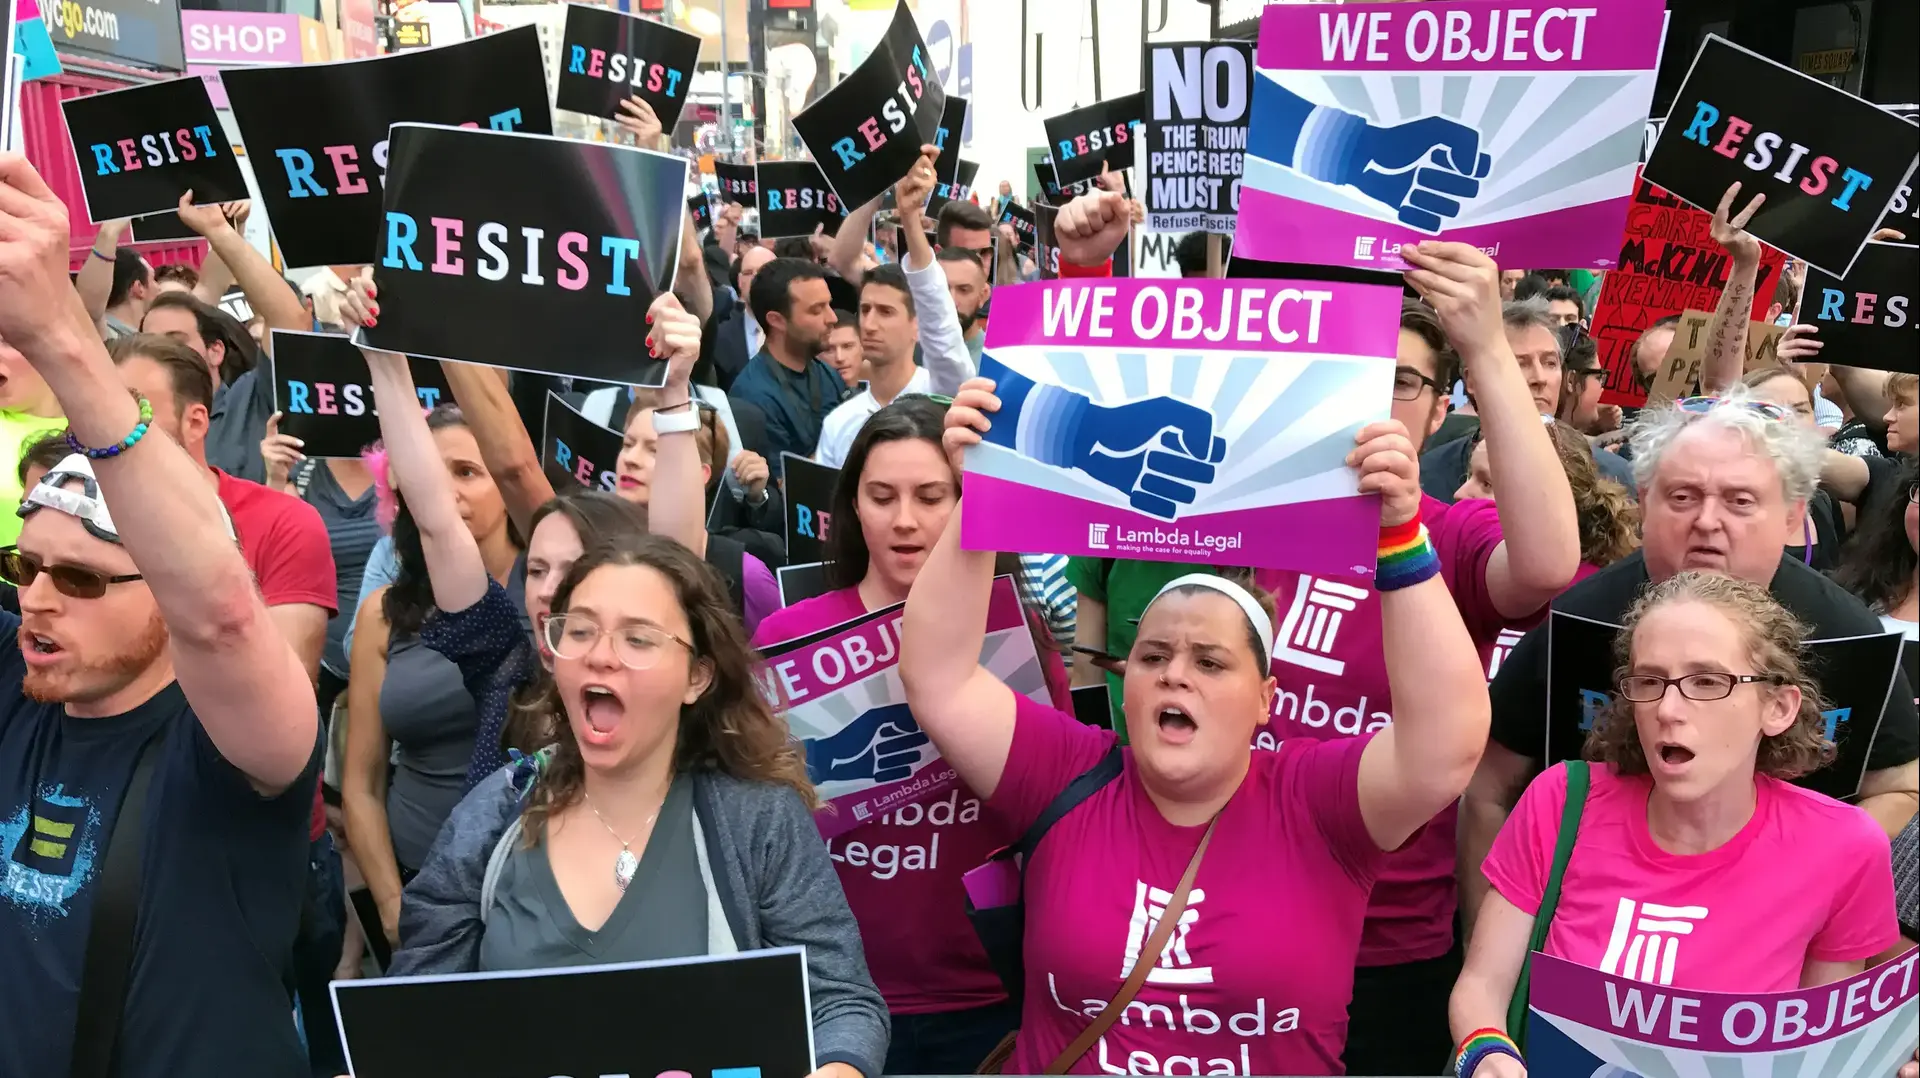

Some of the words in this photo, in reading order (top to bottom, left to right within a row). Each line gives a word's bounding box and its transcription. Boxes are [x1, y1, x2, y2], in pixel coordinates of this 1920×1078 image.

[190, 24, 287, 54] SHOP
[1319, 11, 1392, 62] WE
[1405, 7, 1598, 62] OBJECT
[569, 44, 683, 98] RESIST
[1152, 46, 1247, 122] NO
[831, 44, 928, 172] RESIST
[90, 125, 217, 176] RESIST
[1151, 150, 1207, 175] PENCE
[1161, 124, 1197, 149] THE
[1201, 125, 1249, 150] TRUM
[1682, 101, 1874, 213] RESIST
[1151, 175, 1223, 211] MUST
[382, 211, 640, 297] RESIST
[1042, 286, 1115, 338] WE
[1131, 287, 1333, 344] OBJECT
[1817, 287, 1919, 330] RES
[1116, 525, 1190, 546] Lambda
[1194, 530, 1242, 552] Legal
[1116, 543, 1141, 553] making
[1155, 546, 1171, 554] case
[1172, 546, 1183, 554] for
[1184, 549, 1212, 558] equality
[873, 777, 930, 808] Lambda
[1048, 972, 1301, 1037] Lambda
[1604, 980, 1701, 1042] WE
[1721, 952, 1919, 1046] OBJECT
